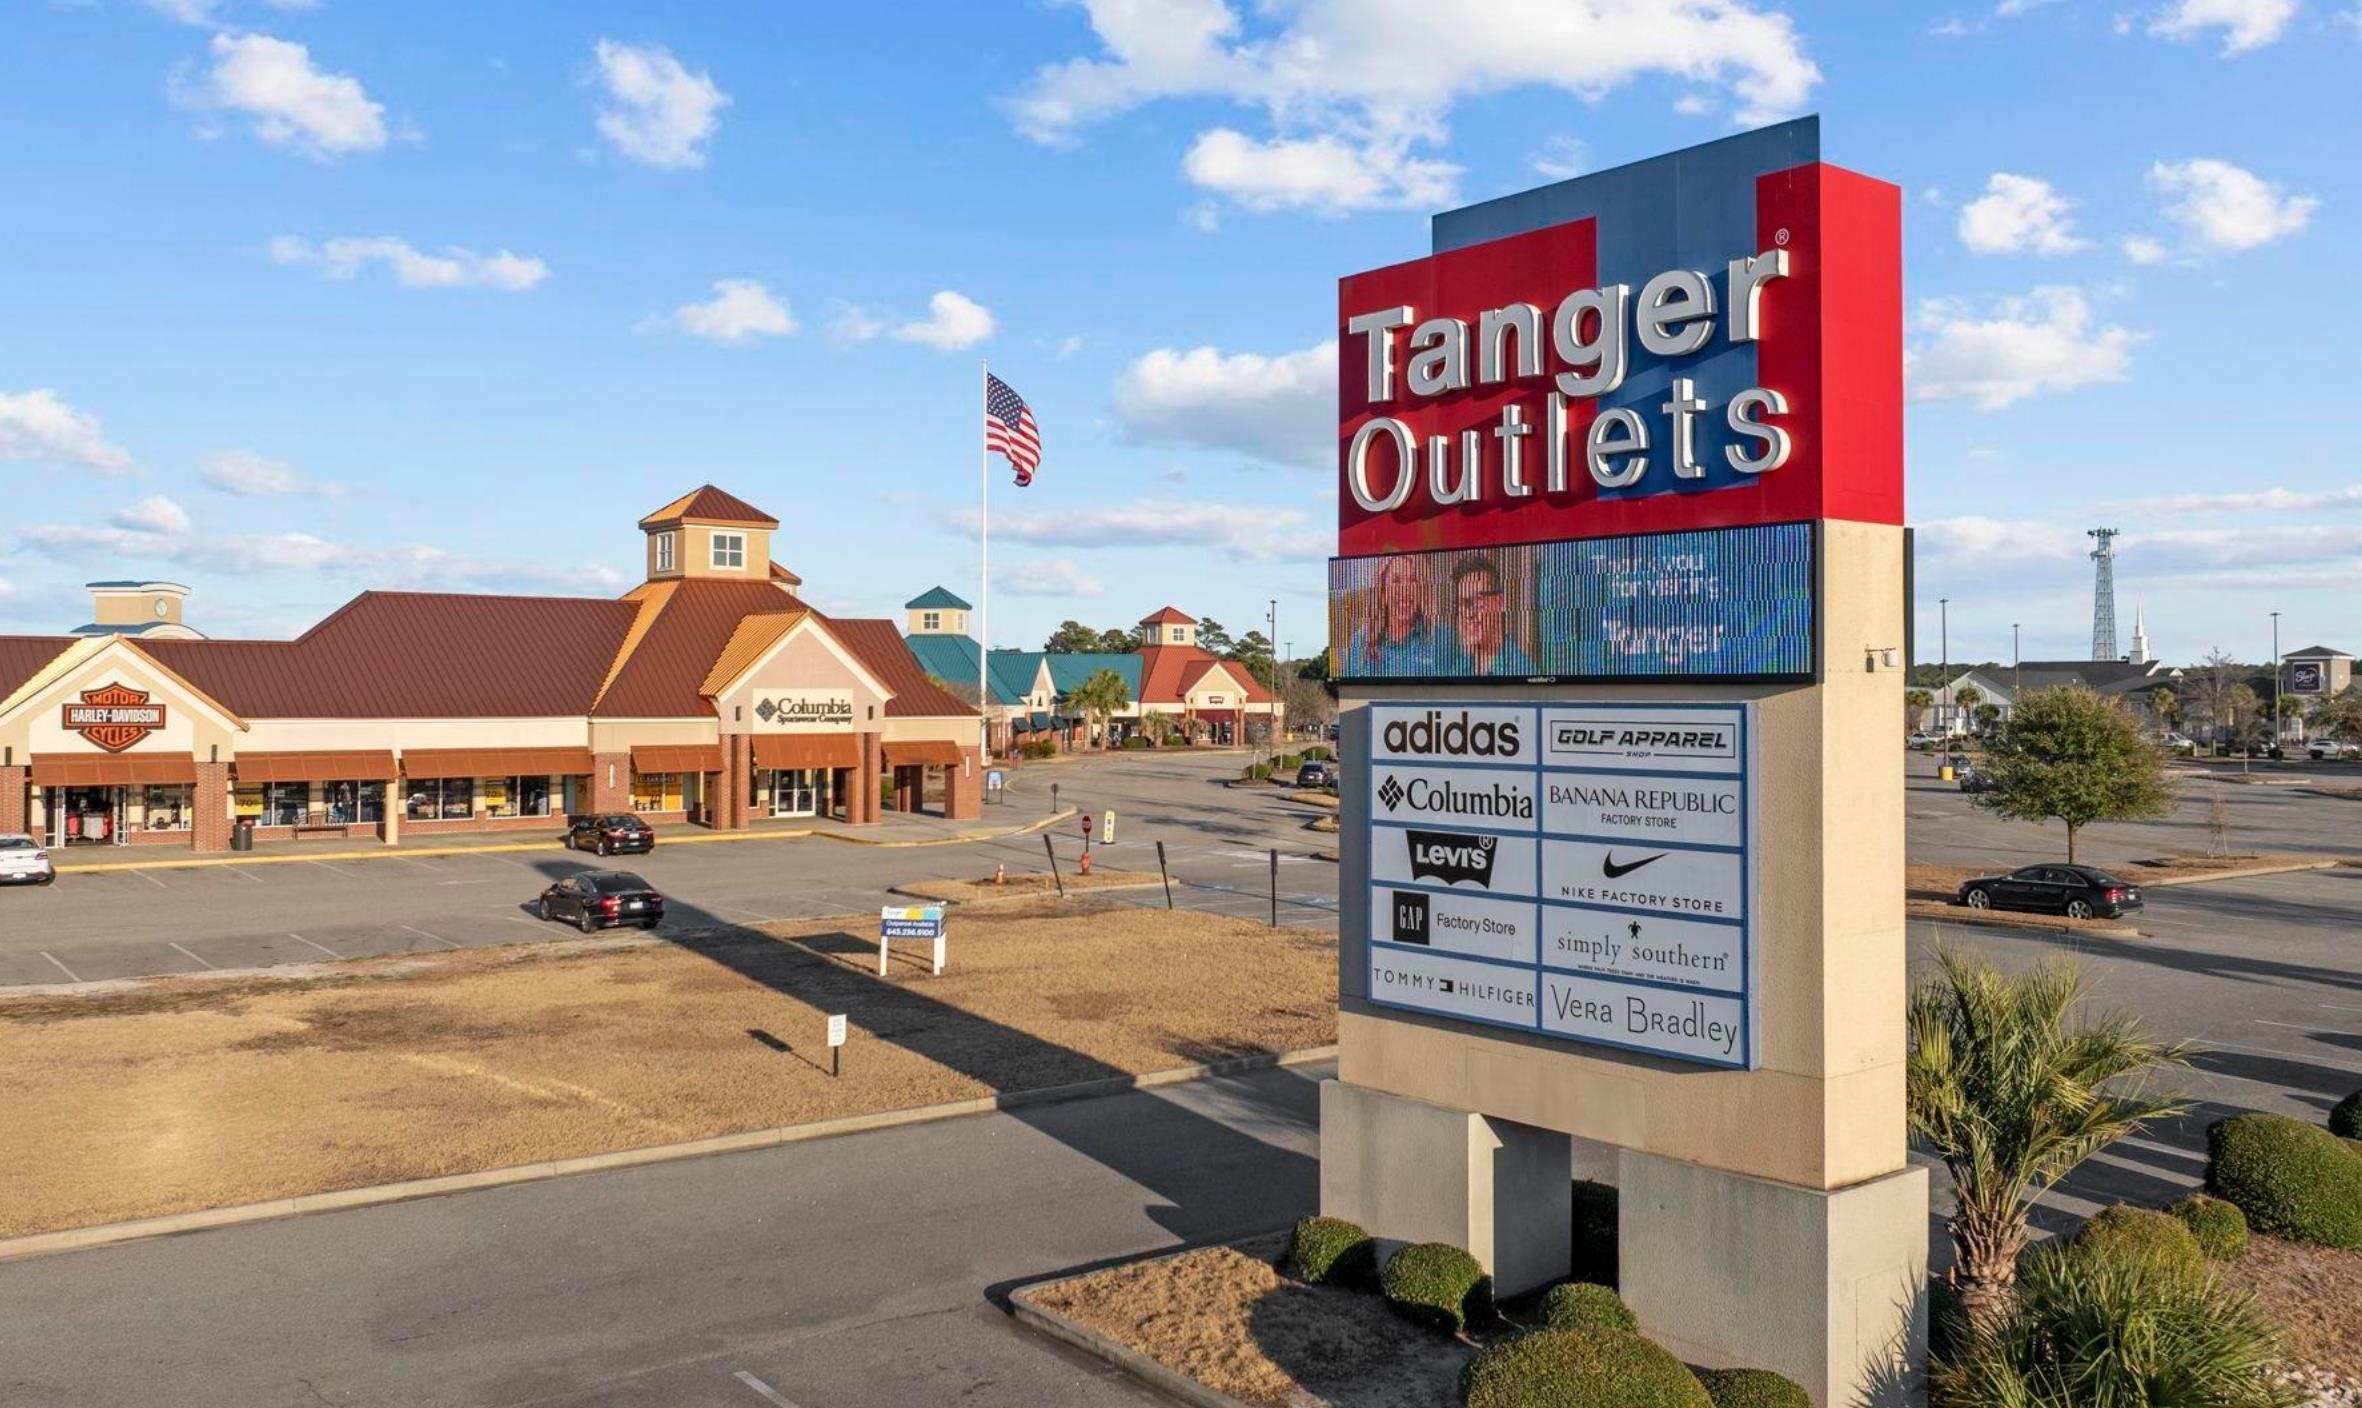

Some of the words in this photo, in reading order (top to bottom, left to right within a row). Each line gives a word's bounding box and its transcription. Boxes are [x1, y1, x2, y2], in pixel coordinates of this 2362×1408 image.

[1349, 248, 1789, 397] Tanger
[1348, 377, 1792, 512] Outlets
[1603, 620, 1723, 664] Tanger
[92, 691, 139, 704] MOTOR
[777, 697, 852, 715] Columbia
[71, 709, 159, 723] HARLEY-DAVIDSON
[92, 727, 137, 744] CYCLES
[1384, 711, 1520, 757] adidas
[1558, 729, 1615, 745] GOLF
[1618, 730, 1727, 749] APPAREL
[1626, 750, 1652, 758] SHOP
[1407, 778, 1533, 819] Columbia
[1550, 785, 1630, 809] BANANA
[1635, 790, 1735, 815] REPUBLIC
[1601, 813, 1642, 826] FACTORY
[1645, 816, 1677, 828] STORE
[1561, 886, 1595, 899] NIKE
[1602, 890, 1667, 907] FACTORY
[1672, 898, 1723, 912] STORE
[1399, 904, 1423, 931] GAP
[1437, 913, 1481, 935] Factory
[1482, 919, 1516, 935] Store
[1558, 931, 1621, 965] simply
[1632, 943, 1724, 971] southern
[1374, 967, 1435, 991] TOMMY
[1459, 981, 1535, 1007] HILFIGER
[1551, 984, 1613, 1024] Vera
[1626, 996, 1737, 1056] Bradley
